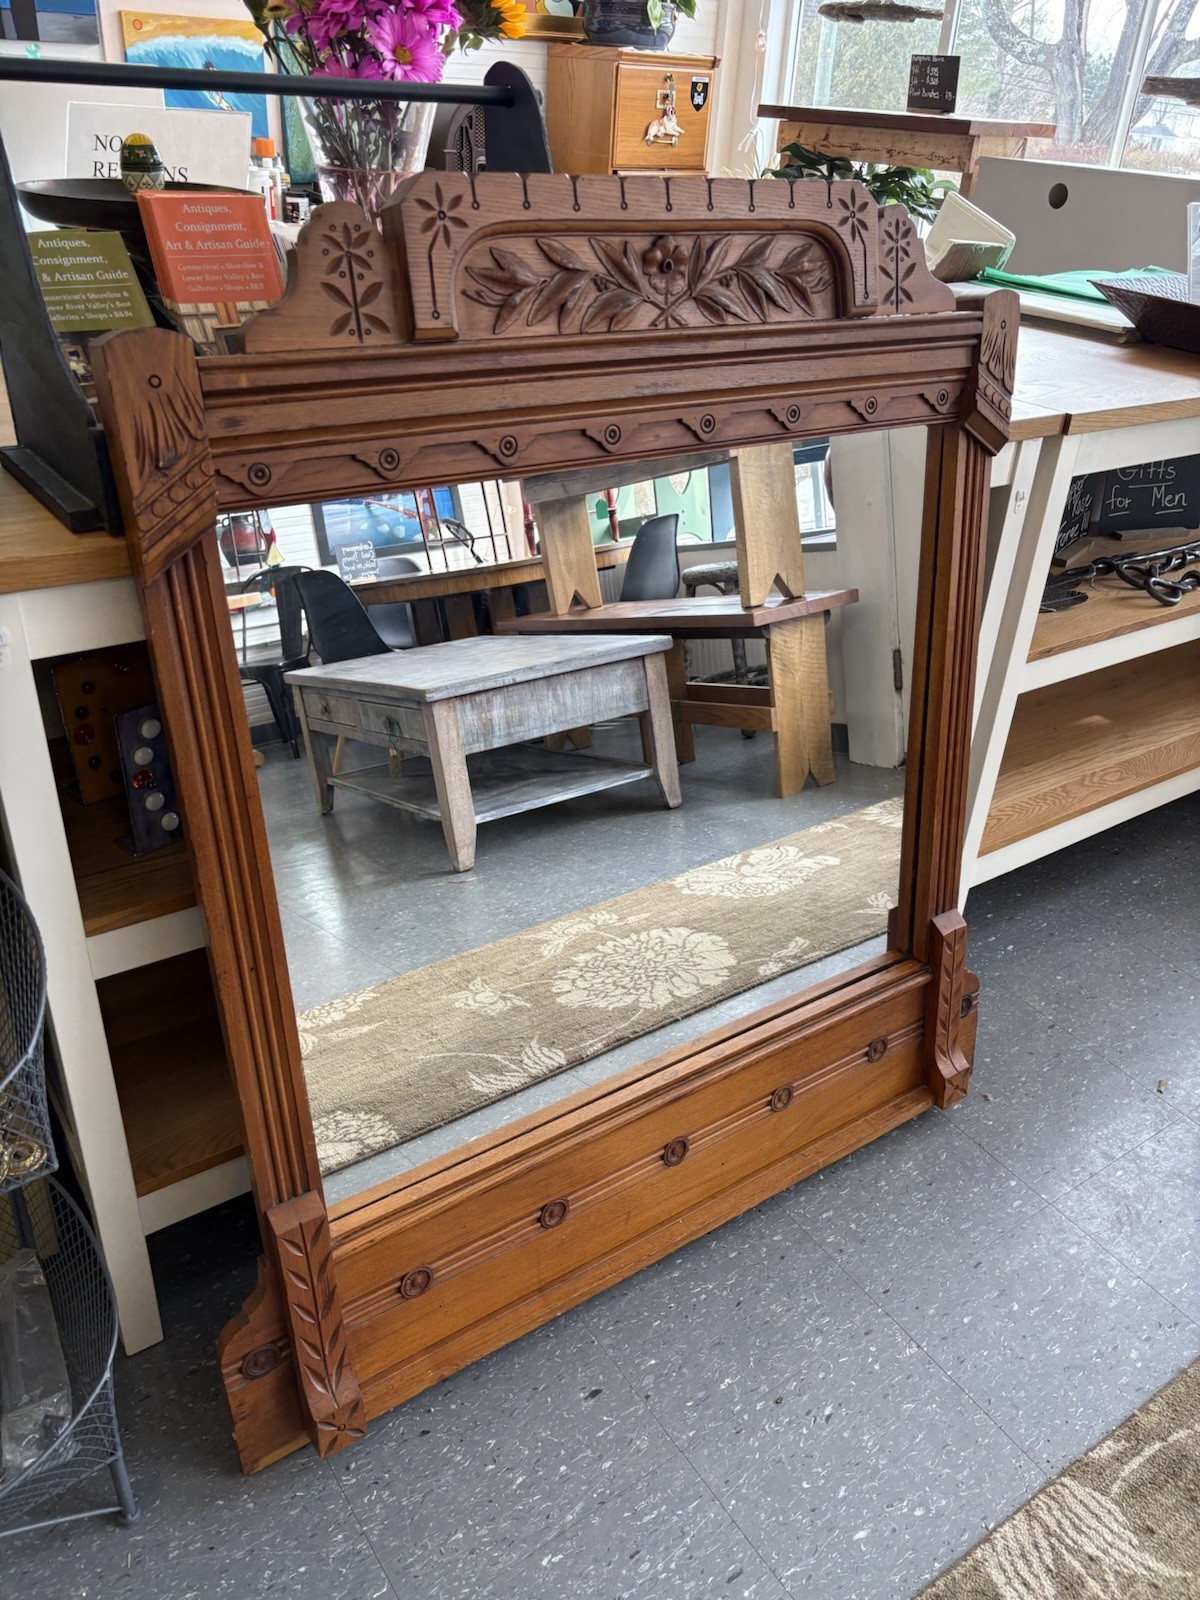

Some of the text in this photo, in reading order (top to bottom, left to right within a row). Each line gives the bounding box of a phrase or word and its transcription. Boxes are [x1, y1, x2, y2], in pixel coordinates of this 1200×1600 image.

[93, 134, 124, 153] NO
[92, 160, 188, 183] RENS
[182, 203, 232, 216] Antiques,
[175, 221, 247, 234] Consignment,
[38, 238, 91, 250] Antiques,
[165, 238, 265, 251] Art & Artisan Guide
[32, 254, 108, 267] Consignment,
[42, 269, 130, 282] & Artisan Guide
[1105, 484, 1132, 510] for
[1151, 484, 1188, 508] Men
